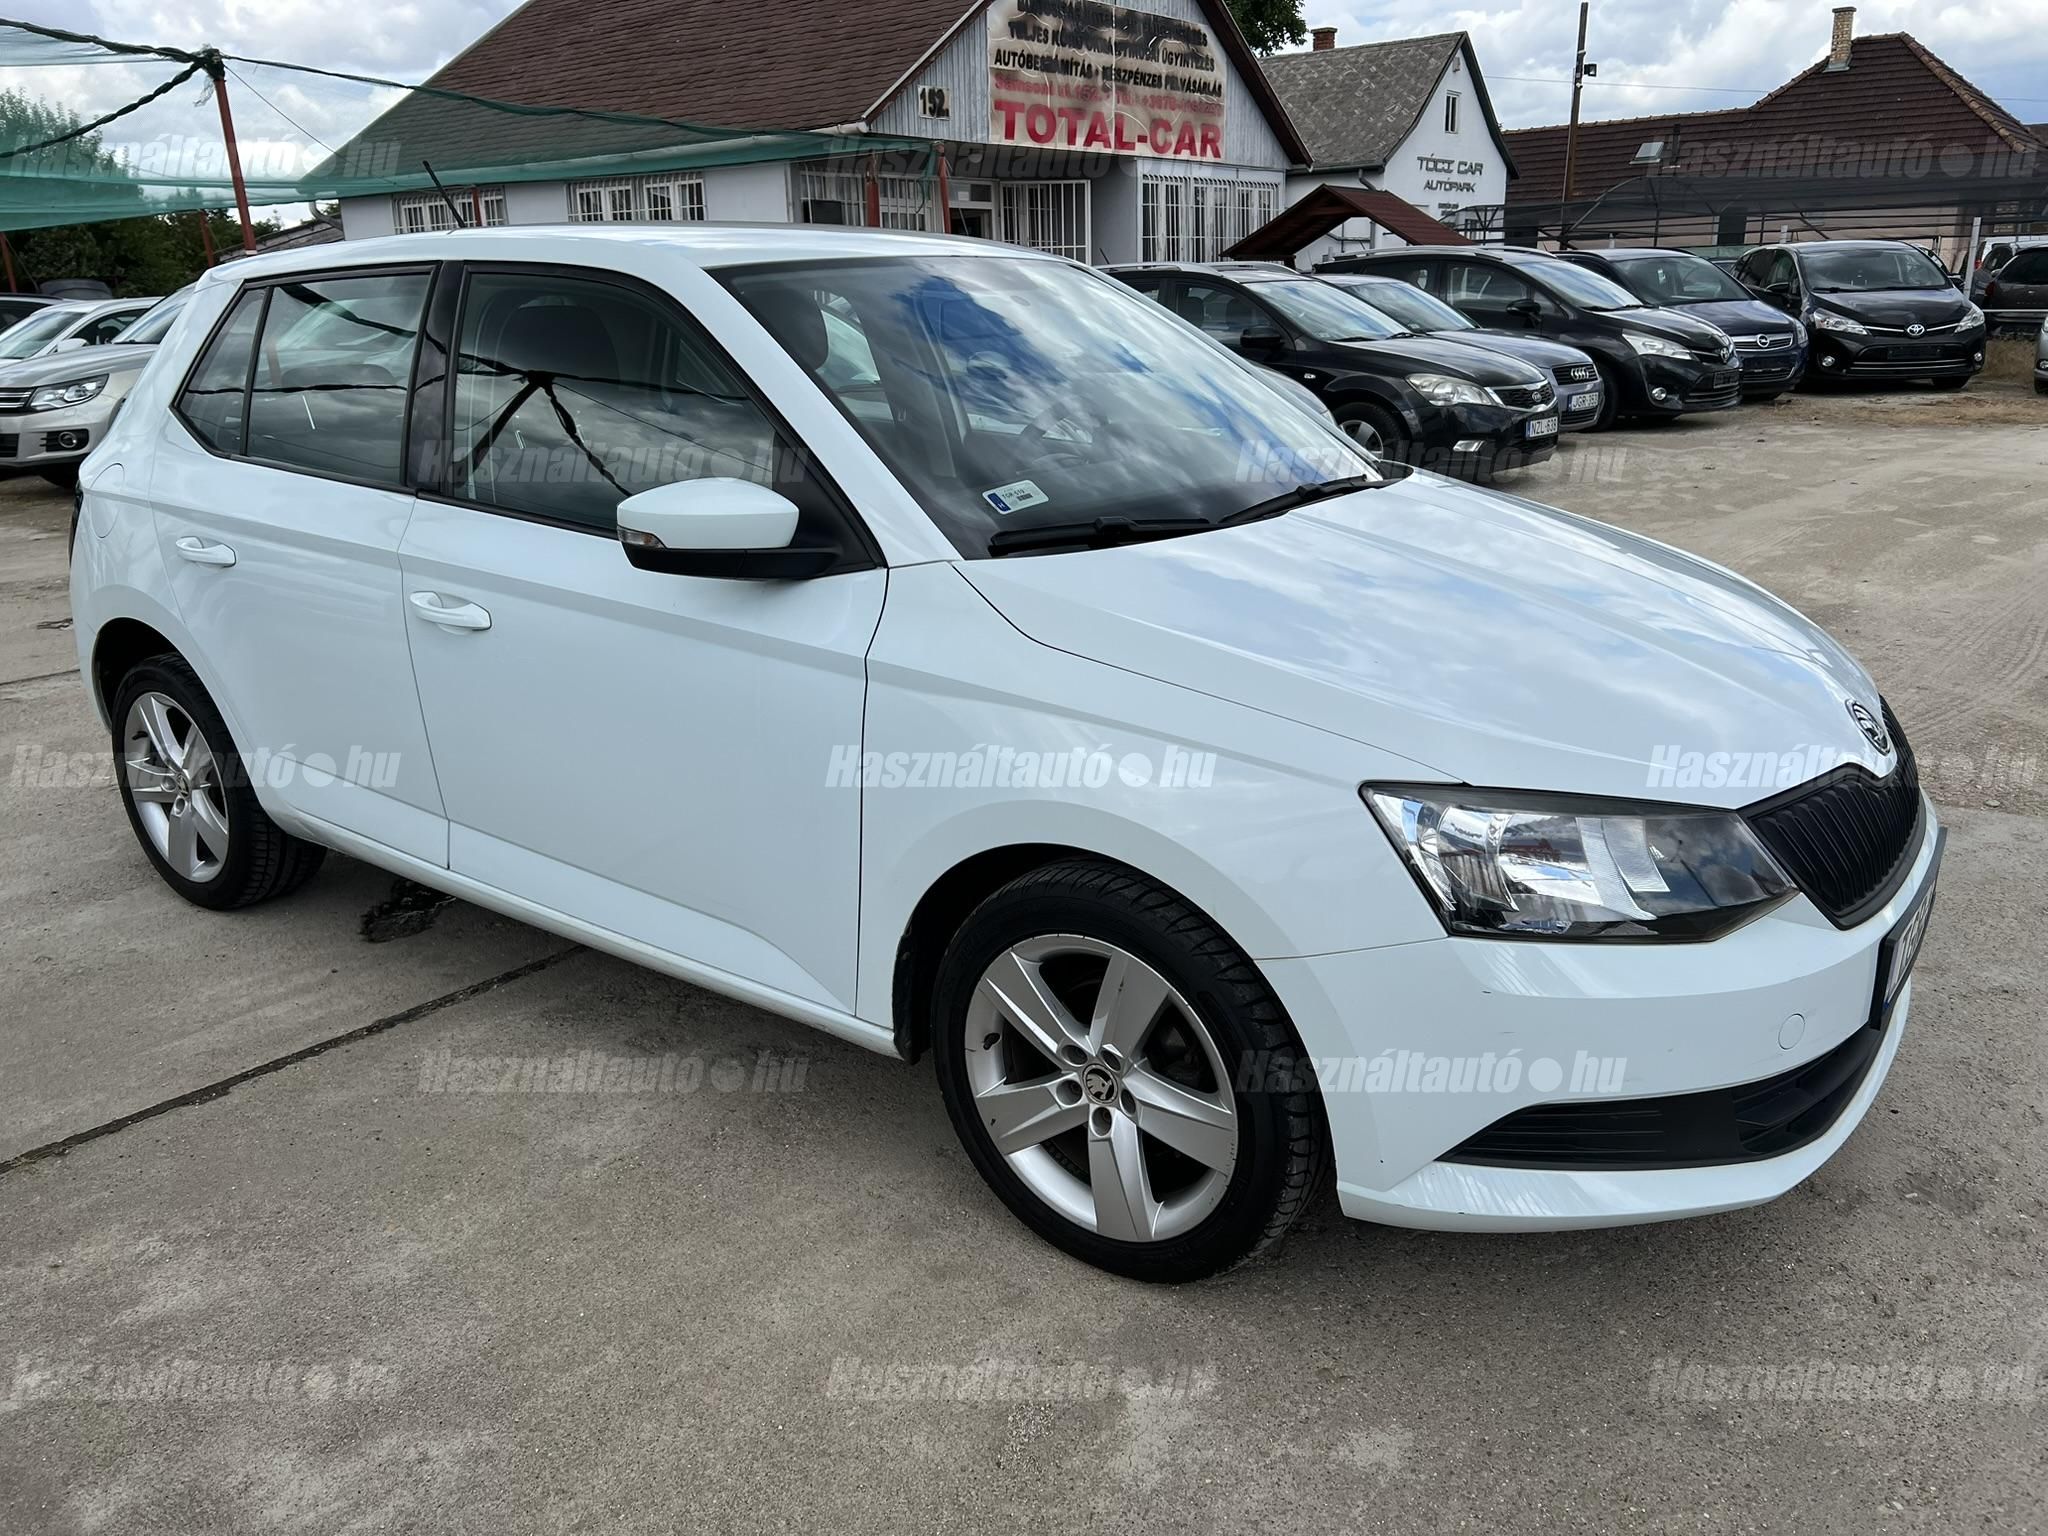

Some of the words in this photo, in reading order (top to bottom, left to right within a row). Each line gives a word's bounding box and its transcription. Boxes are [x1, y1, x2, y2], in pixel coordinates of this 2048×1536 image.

[994, 98, 1222, 160] TOTAL-CAR
[1457, 160, 1484, 176] CAR
[1423, 178, 1477, 193] AUTÓPARK
